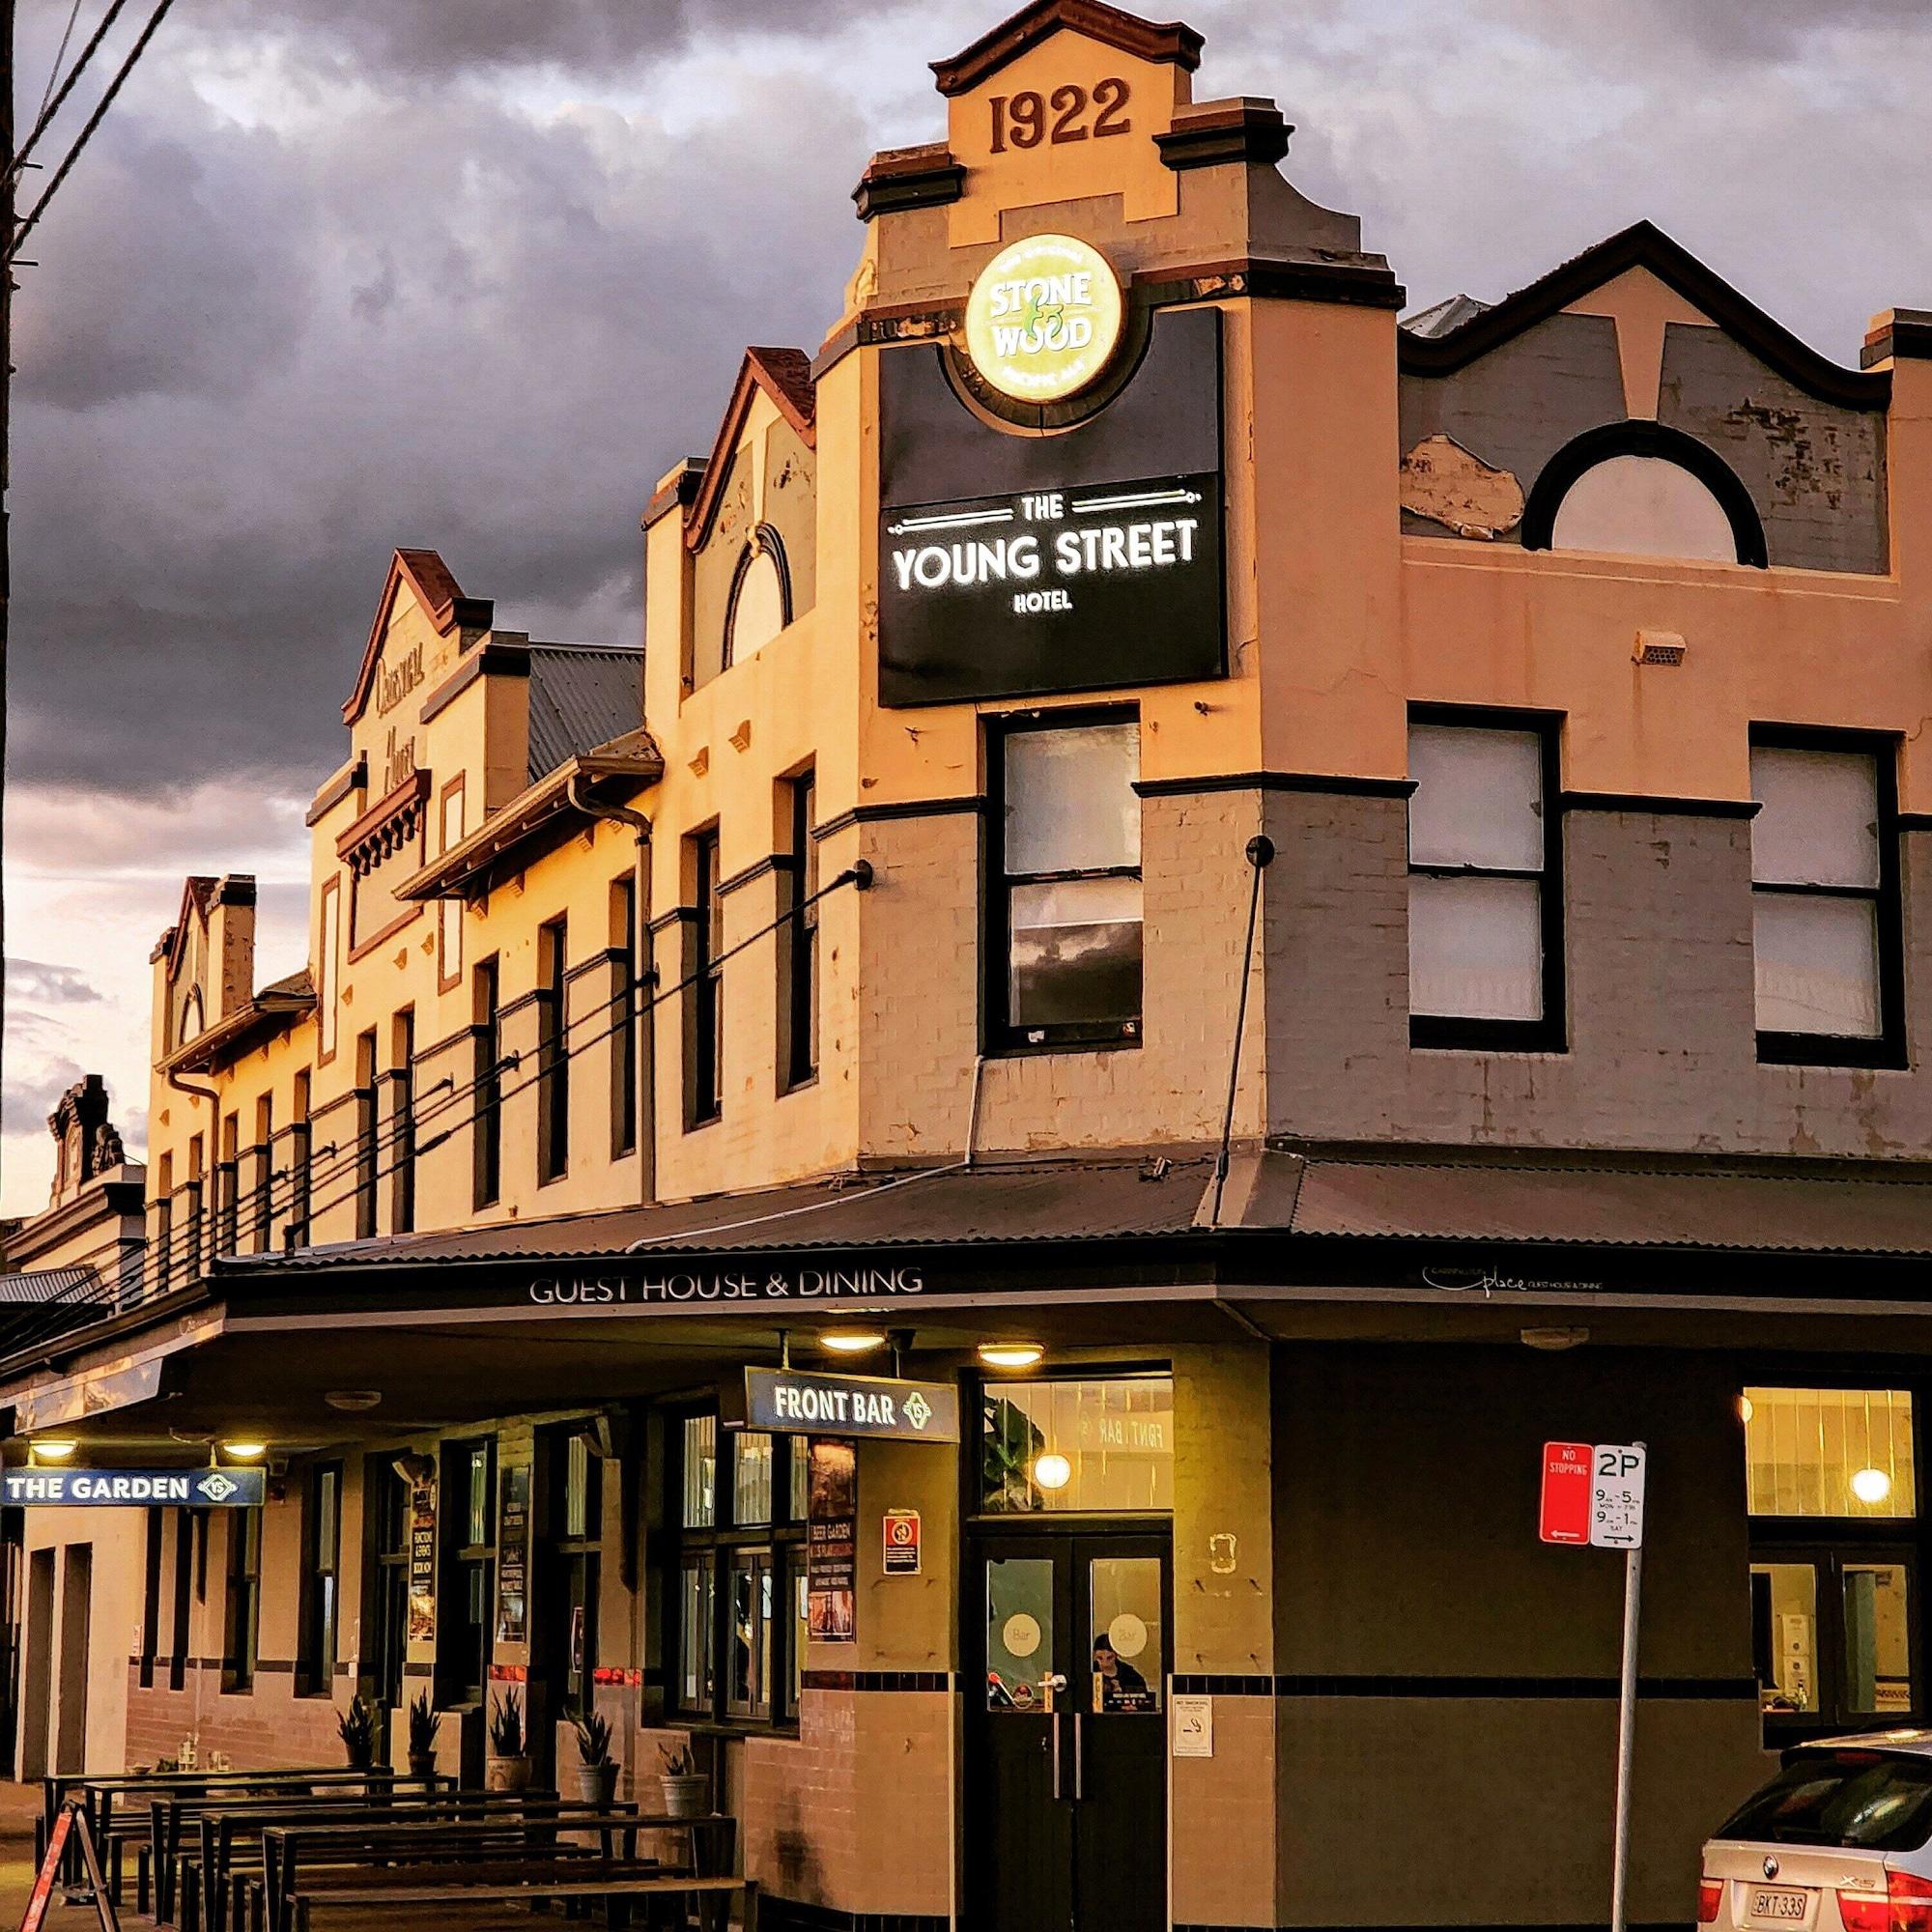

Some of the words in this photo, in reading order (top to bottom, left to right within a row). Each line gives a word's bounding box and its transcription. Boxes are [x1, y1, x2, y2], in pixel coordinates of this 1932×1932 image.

[988, 77, 1131, 154] 1922
[989, 271, 1093, 318] STONE
[990, 317, 1093, 357] WOOD
[1022, 494, 1064, 520] THE
[893, 537, 1039, 589] YOUNG
[1056, 519, 1198, 574] STREET
[1013, 589, 1072, 612] HOTEL
[529, 1276, 629, 1304] GUEST
[643, 1272, 757, 1300] HOUSE
[765, 1271, 789, 1296] &
[799, 1265, 923, 1295] DINING
[774, 1386, 850, 1423] FRONT
[854, 1391, 896, 1425] BAR
[1548, 1462, 1587, 1476] STOPPING
[1561, 1449, 1576, 1462] NO
[1599, 1453, 1640, 1477] 2P
[6, 1477, 64, 1498] THE
[71, 1476, 189, 1499] GARDEN
